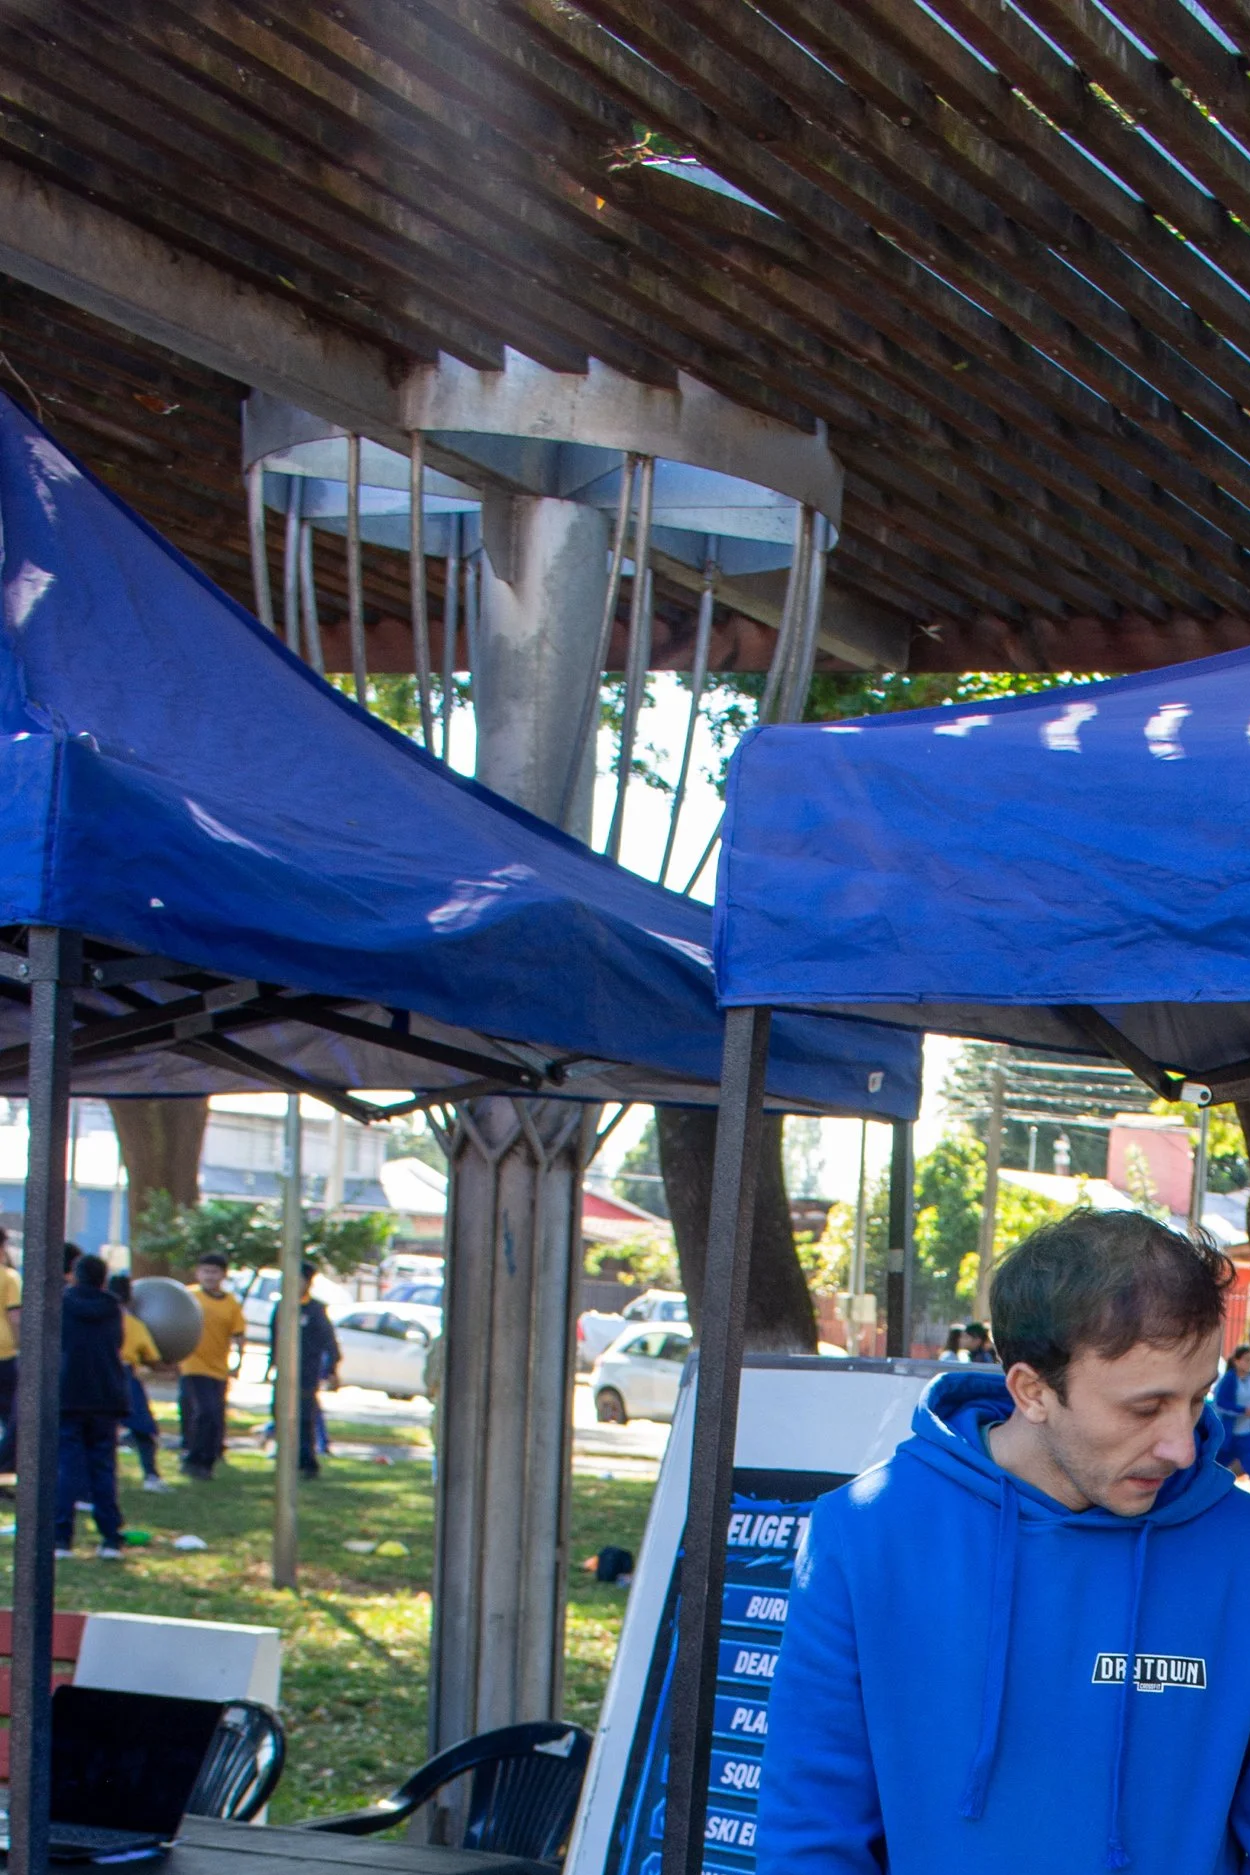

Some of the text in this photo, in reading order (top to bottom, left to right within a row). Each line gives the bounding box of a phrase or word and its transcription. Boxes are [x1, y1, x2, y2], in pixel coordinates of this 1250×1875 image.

[727, 1513, 795, 1549] ELIGE
[730, 1707, 769, 1735] PLA
[720, 1761, 762, 1790] SQU
[704, 1816, 740, 1844] SKI
